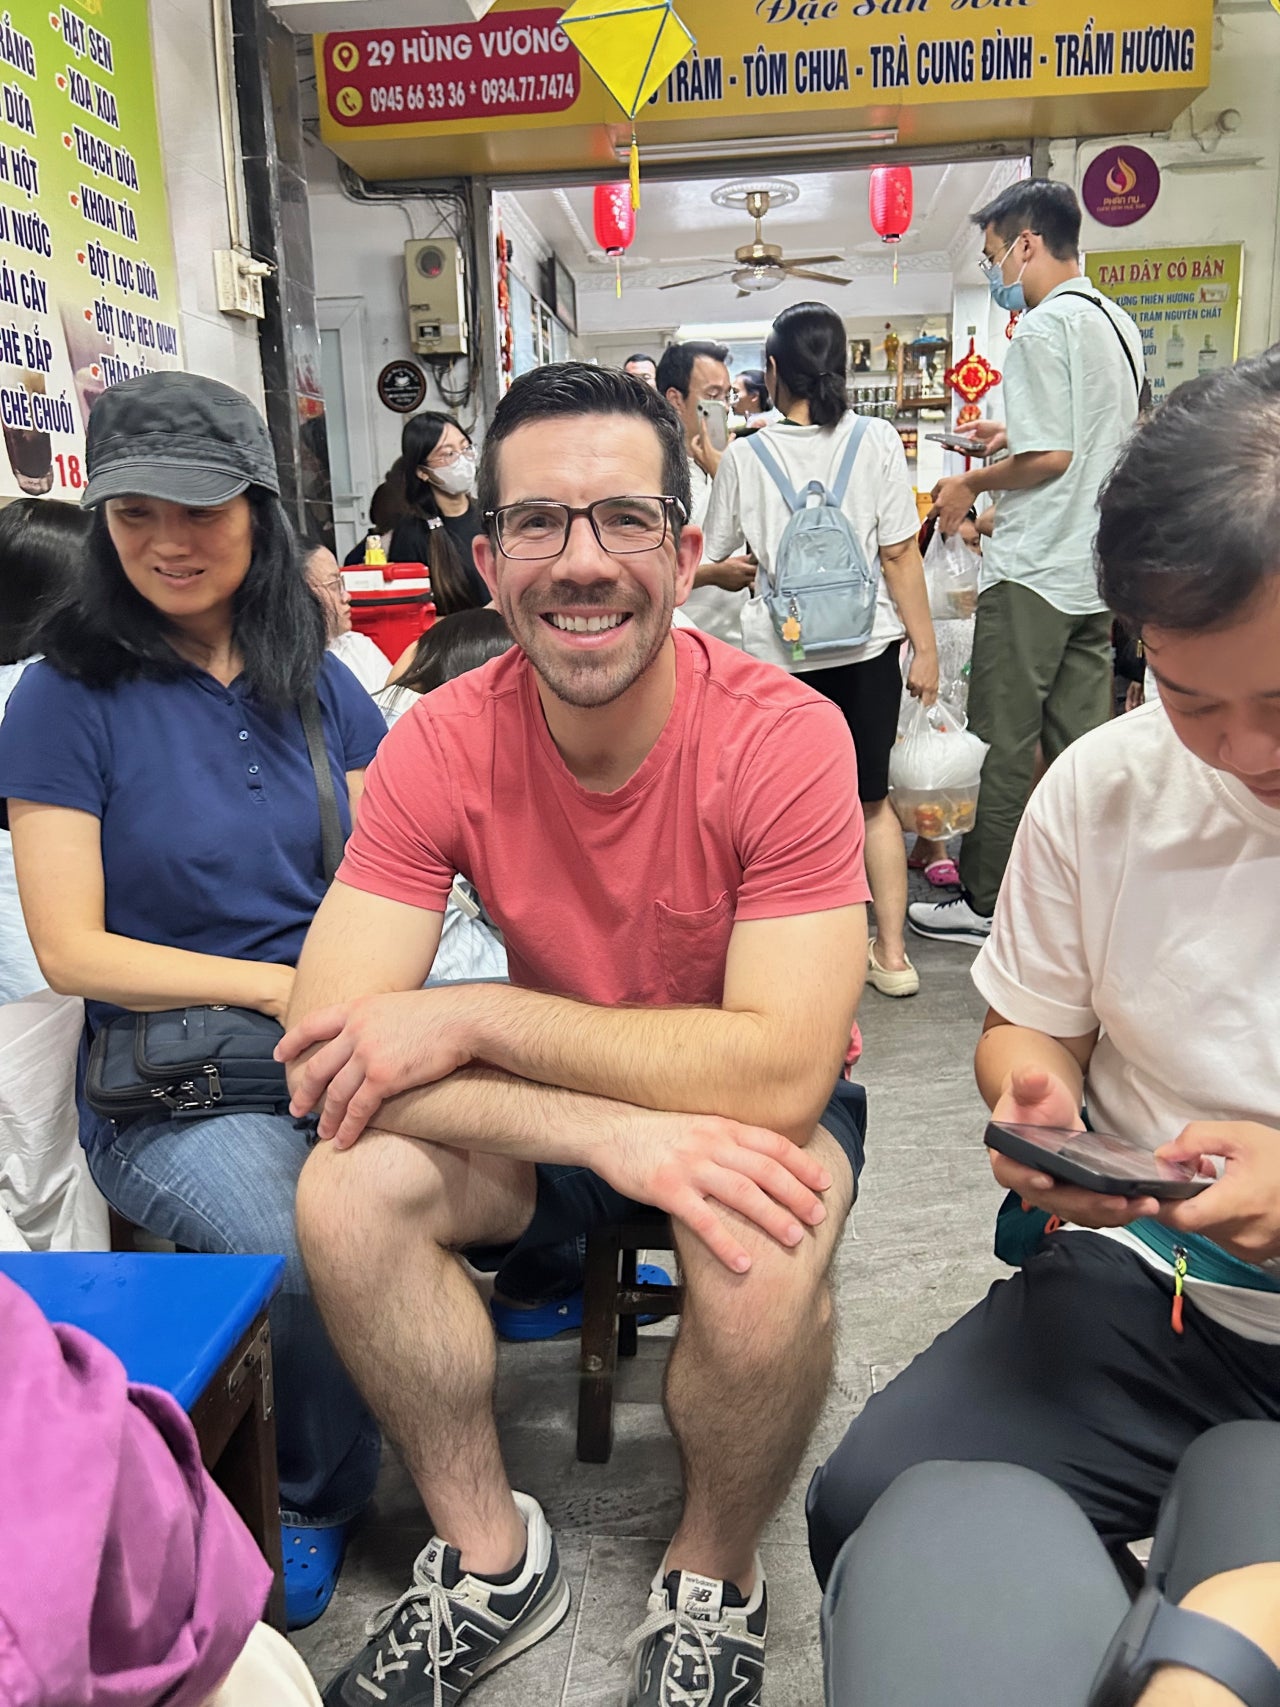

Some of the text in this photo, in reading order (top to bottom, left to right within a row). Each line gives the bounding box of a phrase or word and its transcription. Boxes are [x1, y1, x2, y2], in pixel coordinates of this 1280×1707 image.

[61, 7, 113, 72] HẠT SEN
[367, 26, 570, 67] 29 HÙNG VƯƠNG
[743, 44, 787, 97] TÔM
[795, 48, 849, 93] CHUA
[870, 35, 909, 88] TRÀ
[917, 40, 974, 85] CUNG
[981, 29, 1032, 81] ĐÌNH
[1055, 18, 1114, 77] TRẦM
[1121, 26, 1195, 74] HƯƠNG
[3, 84, 35, 135] DỪA
[67, 67, 119, 128] XOA XOA
[370, 73, 574, 113] 0945 66 33 36 0934.77.7474
[11, 148, 38, 199] HỘT
[73, 126, 139, 191] THẠCH DỪA
[81, 186, 118, 233] KHOAI
[11, 212, 52, 258] NƯỚC
[20, 269, 48, 314] CÂY
[87, 241, 159, 300] BỘT LỌC DỪA
[1099, 255, 1225, 287] TẠI ĐÂY CÓ BÁN
[24, 324, 52, 372] BẮP
[94, 297, 178, 355] BỘT LỌC HEO QUAY
[1, 386, 75, 434] CHÈ CHUỐI
